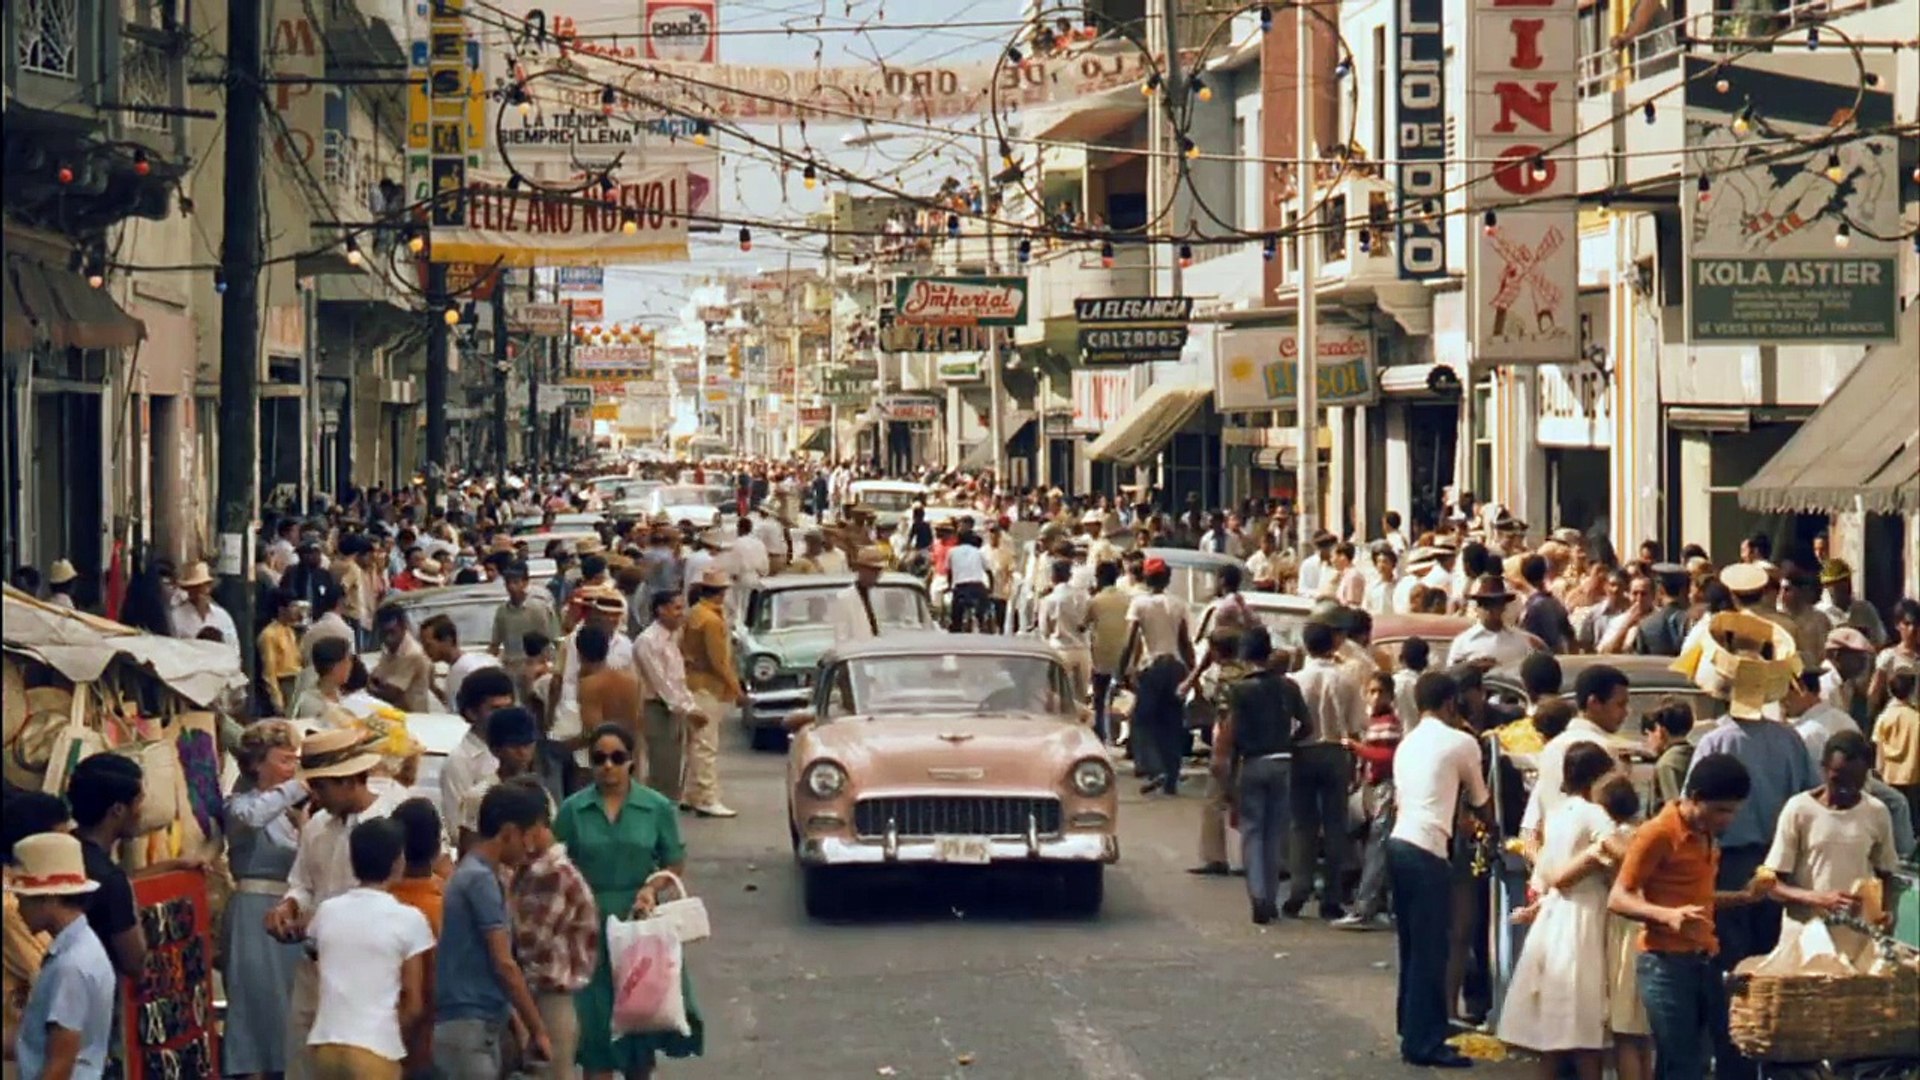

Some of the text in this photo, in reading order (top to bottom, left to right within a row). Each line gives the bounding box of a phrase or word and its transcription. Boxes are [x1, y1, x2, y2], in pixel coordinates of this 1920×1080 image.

[1493, 0, 1557, 195] INO
[523, 112, 544, 128] LA
[578, 130, 632, 144] LLENA
[1401, 123, 1442, 147] DE
[1402, 163, 1442, 272] ORO
[1698, 261, 1882, 286] KOLA ASTIER
[905, 279, 1012, 314] Imperial
[1079, 300, 1187, 320] LA ELEGANCIA
[1087, 330, 1182, 348] CALZADOS
